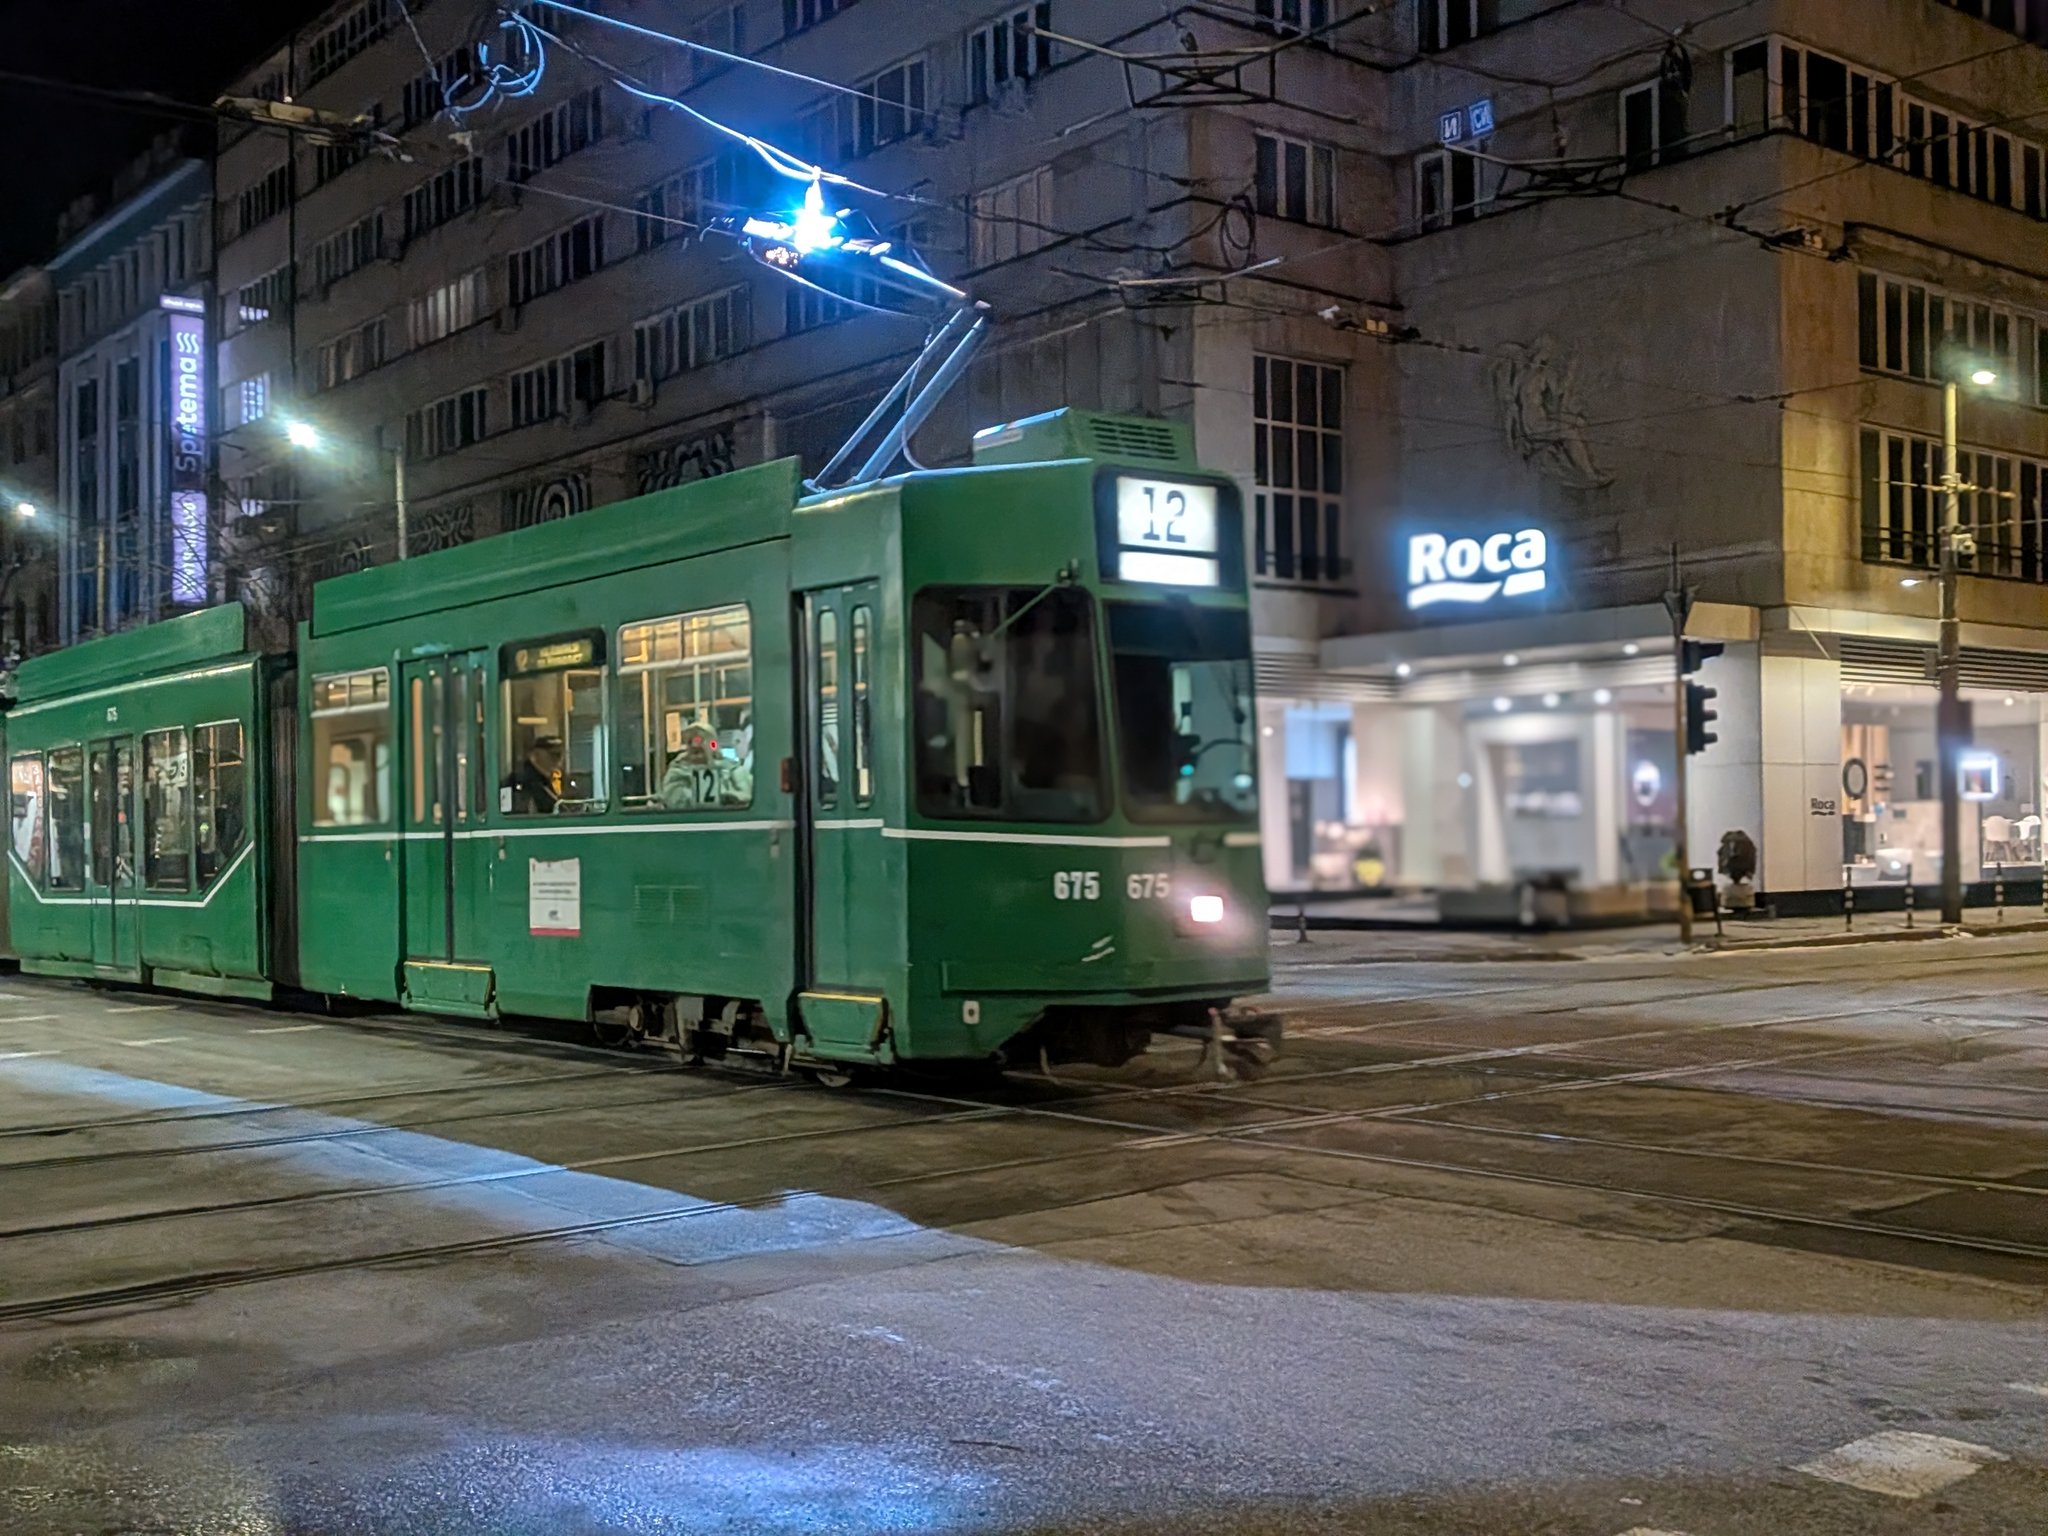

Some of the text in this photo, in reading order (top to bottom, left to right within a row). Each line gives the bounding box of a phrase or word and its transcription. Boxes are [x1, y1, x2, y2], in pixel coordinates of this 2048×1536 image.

[1142, 486, 1187, 543] 12
[1408, 528, 1546, 585] Roca
[692, 768, 716, 803] 12
[1810, 797, 1836, 810] Roca
[1053, 870, 1170, 900] 675 675
